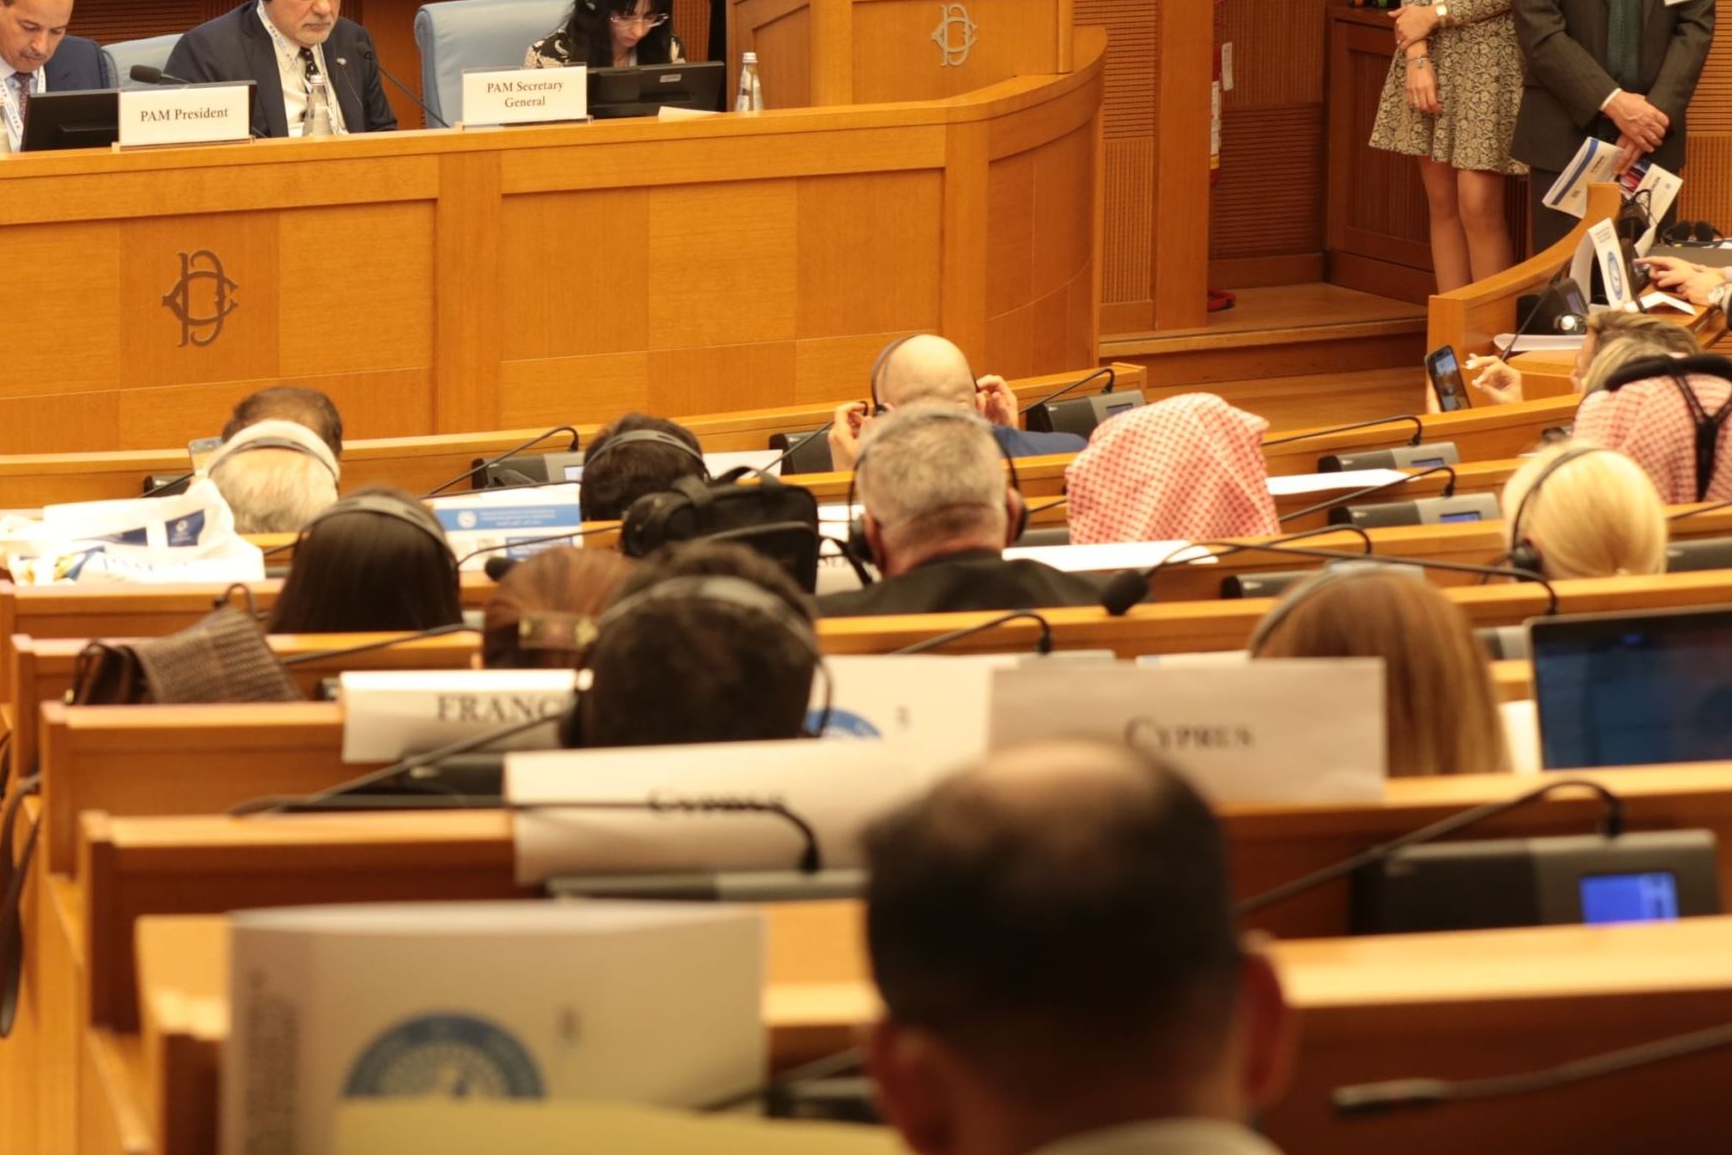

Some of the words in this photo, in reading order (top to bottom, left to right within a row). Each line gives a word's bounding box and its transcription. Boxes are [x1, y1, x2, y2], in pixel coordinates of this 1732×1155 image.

[487, 82, 513, 94] PAM
[516, 80, 564, 95] Secretary
[504, 96, 546, 108] General
[140, 109, 170, 122] PAM
[174, 107, 228, 121] President
[437, 692, 566, 723] FRANC
